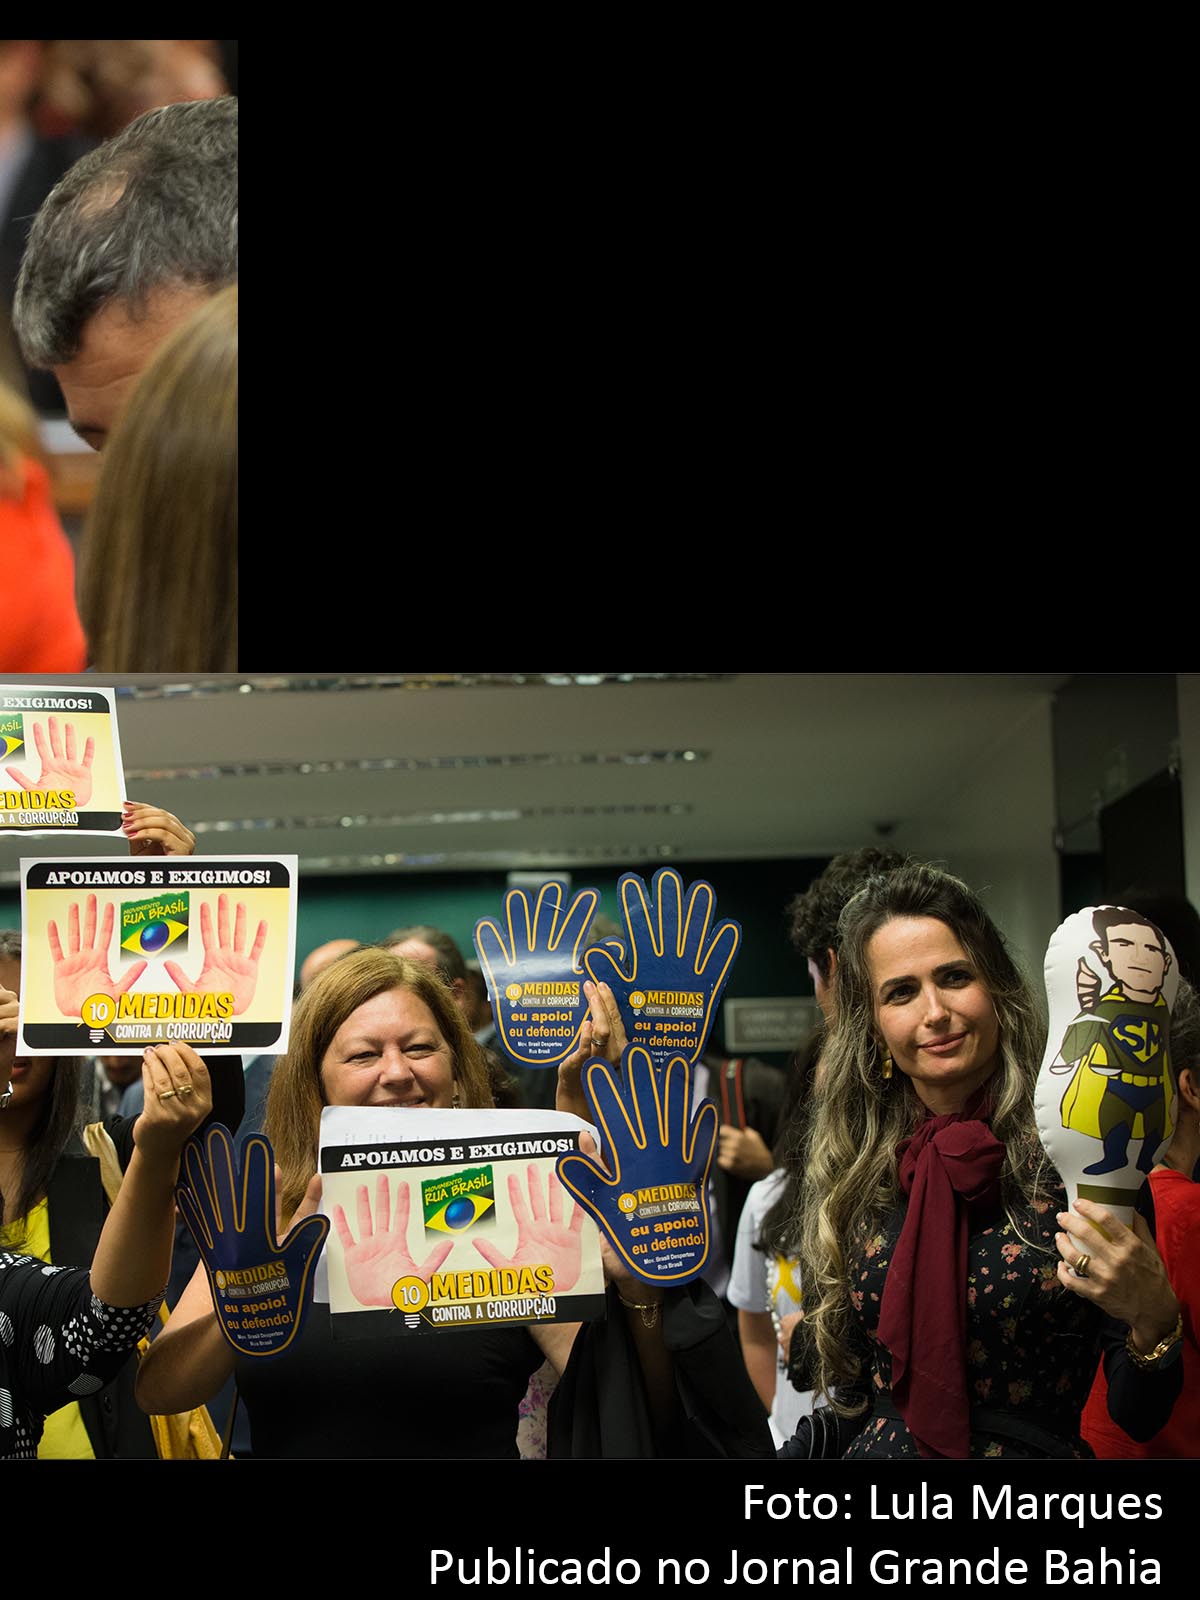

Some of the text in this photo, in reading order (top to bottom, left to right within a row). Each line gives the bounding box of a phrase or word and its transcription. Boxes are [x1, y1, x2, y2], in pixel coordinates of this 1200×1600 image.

[3, 696, 93, 710] EXIGIMOS!
[8, 814, 16, 824] A
[18, 810, 79, 827] CORRUPÇÃO
[46, 870, 271, 885] APOIAMOS E EXIGIMOS!
[123, 910, 146, 927] RUA
[510, 982, 580, 996] 10 MEDIDAS
[90, 993, 235, 1021] 10 MEDIDAS
[547, 995, 580, 1007] CORRUPÇÃO
[634, 992, 704, 1006] 10 MEDIDAS
[511, 1011, 573, 1024] eu apoio!
[671, 1005, 704, 1018] CORRUPÇÃO
[116, 1019, 233, 1043] CONTRA A CORRUPÇÃO
[510, 1026, 575, 1037] eu defendo!
[634, 1021, 697, 1033] eu apoio!
[649, 1035, 698, 1048] defendo!
[340, 1138, 574, 1168] APOIAMOS E EXIGIMOS!
[424, 1178, 462, 1193] MOVIMENTO
[425, 1188, 448, 1206] RUA
[622, 1184, 696, 1209] 10 MEDIDAS
[640, 1205, 660, 1216] CONTRA
[662, 1204, 668, 1212] A
[630, 1216, 699, 1237] eu apoio!
[632, 1232, 705, 1255] eu defendo!
[225, 1262, 286, 1286] MEDIDAS
[400, 1266, 554, 1306] 10 MEDIDAS
[224, 1295, 287, 1314] eu apoio!
[432, 1293, 557, 1322] CONTRA A CORRUPÇÃO
[228, 1310, 294, 1329] eu defendo!
